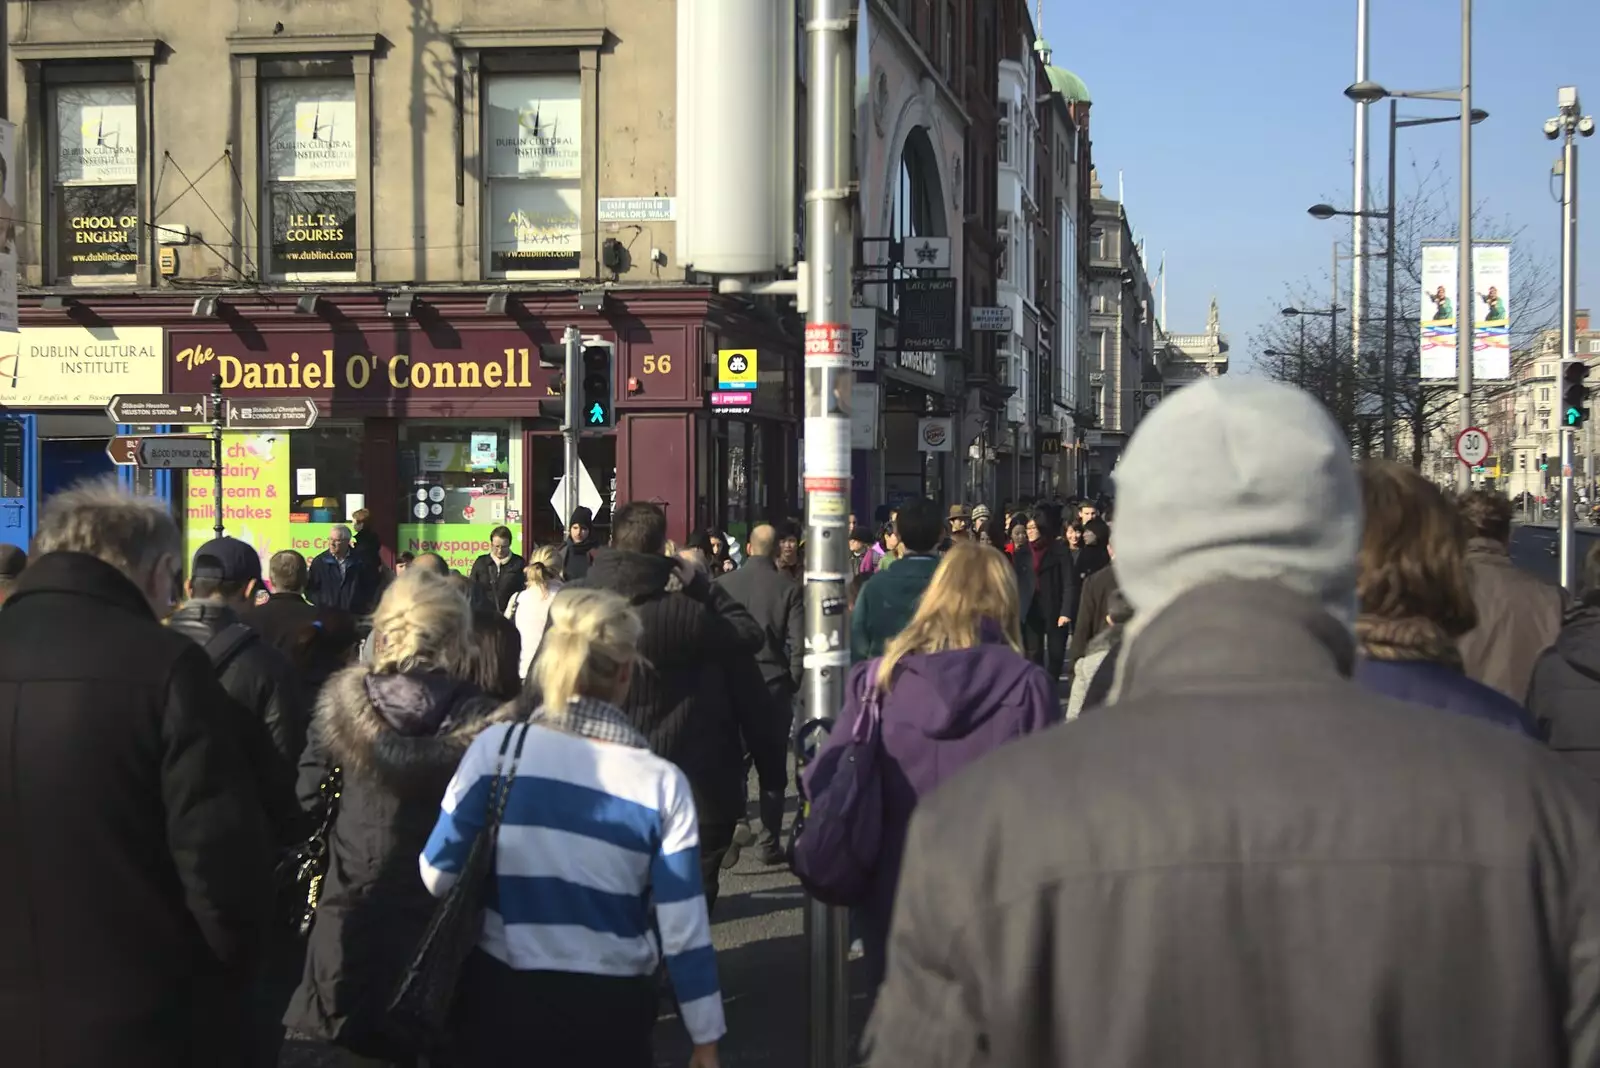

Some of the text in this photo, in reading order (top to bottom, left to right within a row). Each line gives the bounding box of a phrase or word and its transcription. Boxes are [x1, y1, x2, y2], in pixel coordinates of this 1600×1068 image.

[496, 137, 574, 147] DUBLIN CULTURAL
[290, 214, 339, 226] I.E.L.T.S.
[649, 210, 671, 219] WALK
[72, 216, 137, 229] CHOOL OF
[286, 229, 344, 241] COURSES
[72, 252, 138, 262] ww.dublinci.com
[904, 337, 953, 347] PHARMACY
[31, 345, 156, 358] DUBLIN CULTURAL
[61, 361, 130, 374] INSTITUTE
[176, 344, 532, 389] The Daniel O' Connell
[643, 354, 673, 374] 56
[0, 394, 17, 402] hool
[1465, 433, 1480, 450] 30
[266, 484, 277, 498] &
[292, 537, 310, 549] Ice
[409, 538, 493, 555] Newspape
